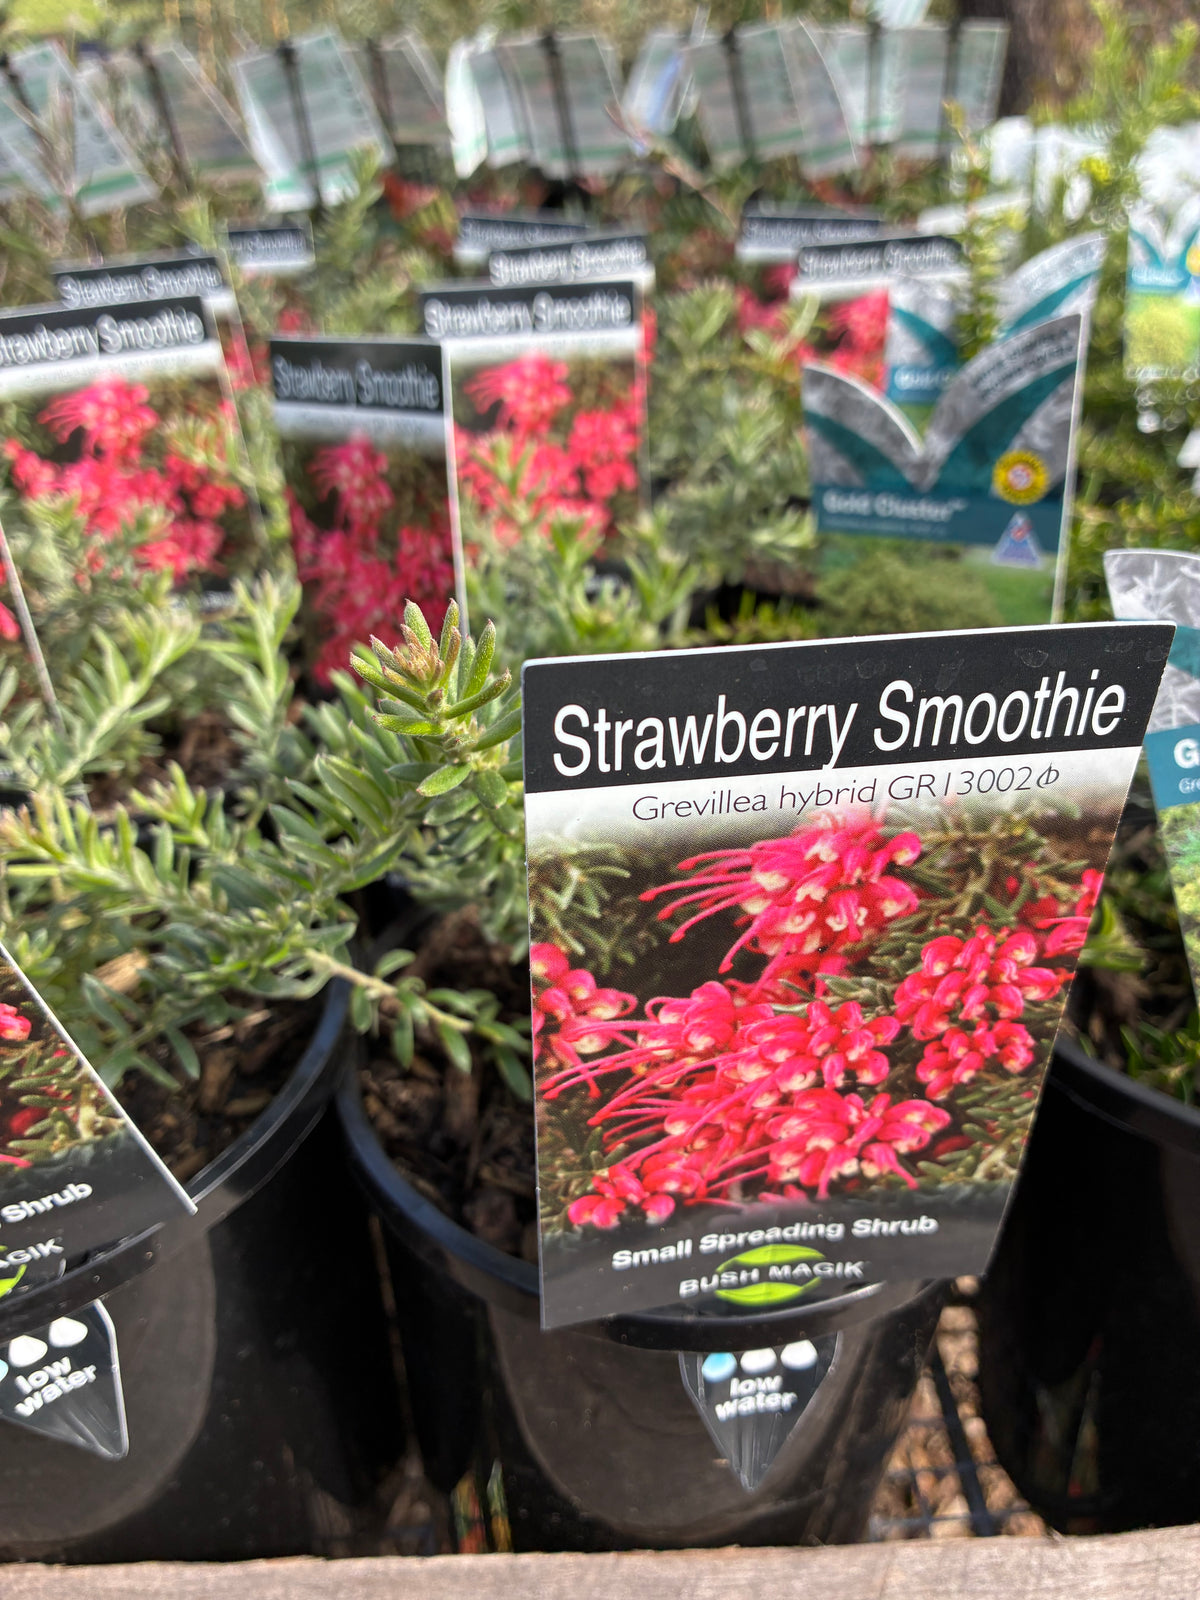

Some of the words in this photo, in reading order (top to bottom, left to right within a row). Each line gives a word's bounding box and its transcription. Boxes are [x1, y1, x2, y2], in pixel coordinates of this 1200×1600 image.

[553, 694, 858, 776] Strawberry
[873, 669, 1126, 752] Smoothie
[633, 788, 768, 821] Grevillea
[780, 780, 875, 818] hybrid
[1, 1182, 93, 1223] Shrub
[612, 1239, 692, 1270] Small
[699, 1221, 844, 1254] Spreading
[851, 1214, 938, 1238] Shrub
[679, 1267, 759, 1299] BUSH
[769, 1261, 864, 1281] MAGIK
[14, 1364, 97, 1418] water
[15, 1356, 72, 1395] low
[730, 1374, 783, 1398] low
[714, 1390, 798, 1421] water
